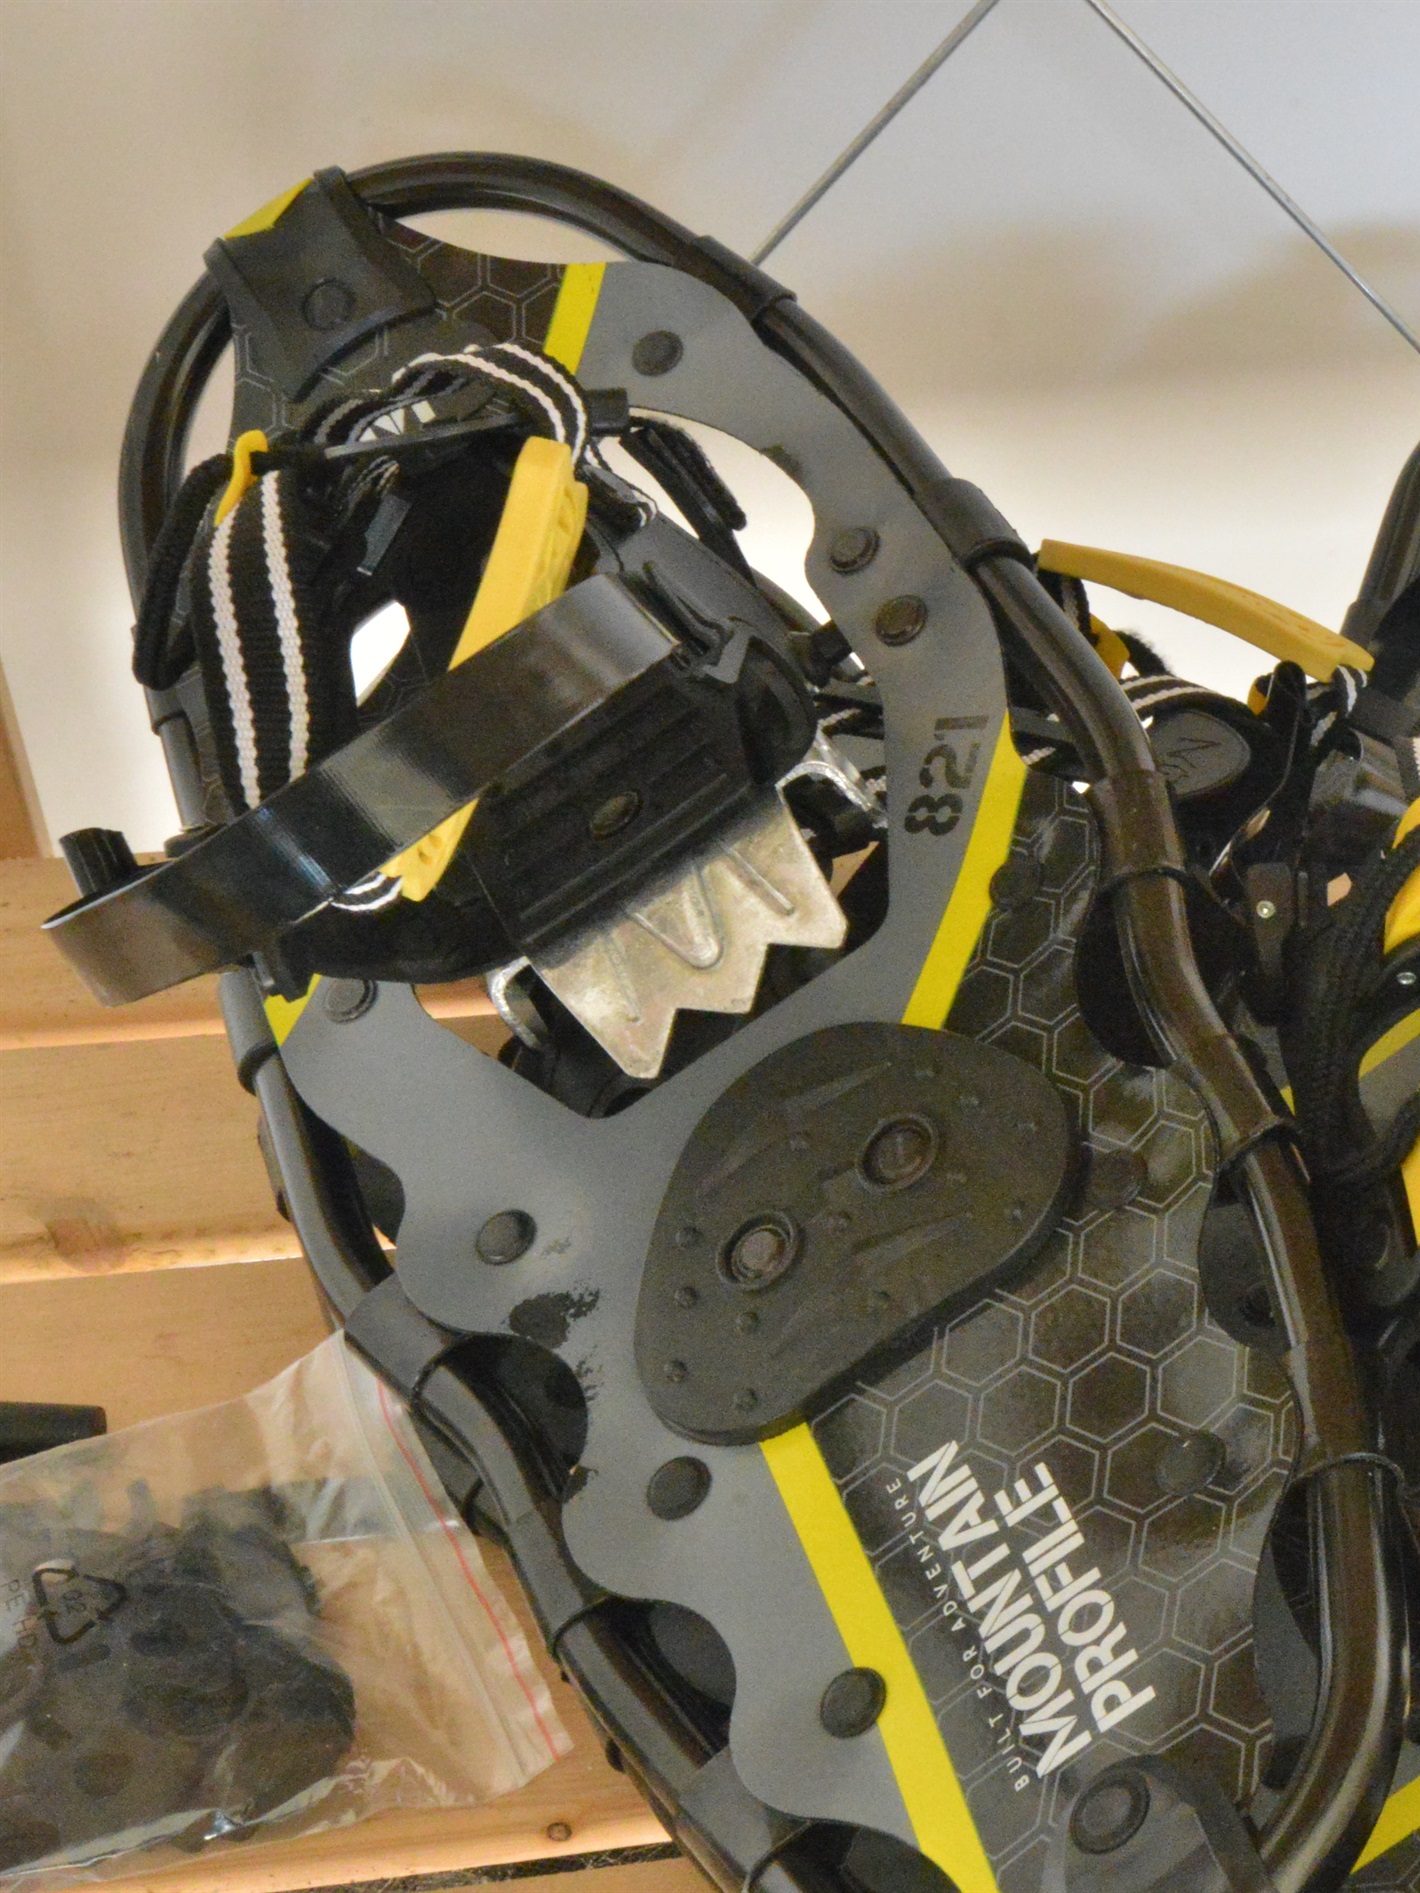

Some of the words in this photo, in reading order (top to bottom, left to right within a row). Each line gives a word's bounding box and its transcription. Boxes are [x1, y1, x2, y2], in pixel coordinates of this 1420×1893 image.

[904, 715, 989, 836] 821
[884, 1477, 967, 1634] ADVENTURE
[907, 1440, 1092, 1779] MOUNTAIN
[994, 1461, 1157, 1734] PROFILE
[961, 1646, 993, 1699] FOR
[988, 1712, 1030, 1792] BUILT
